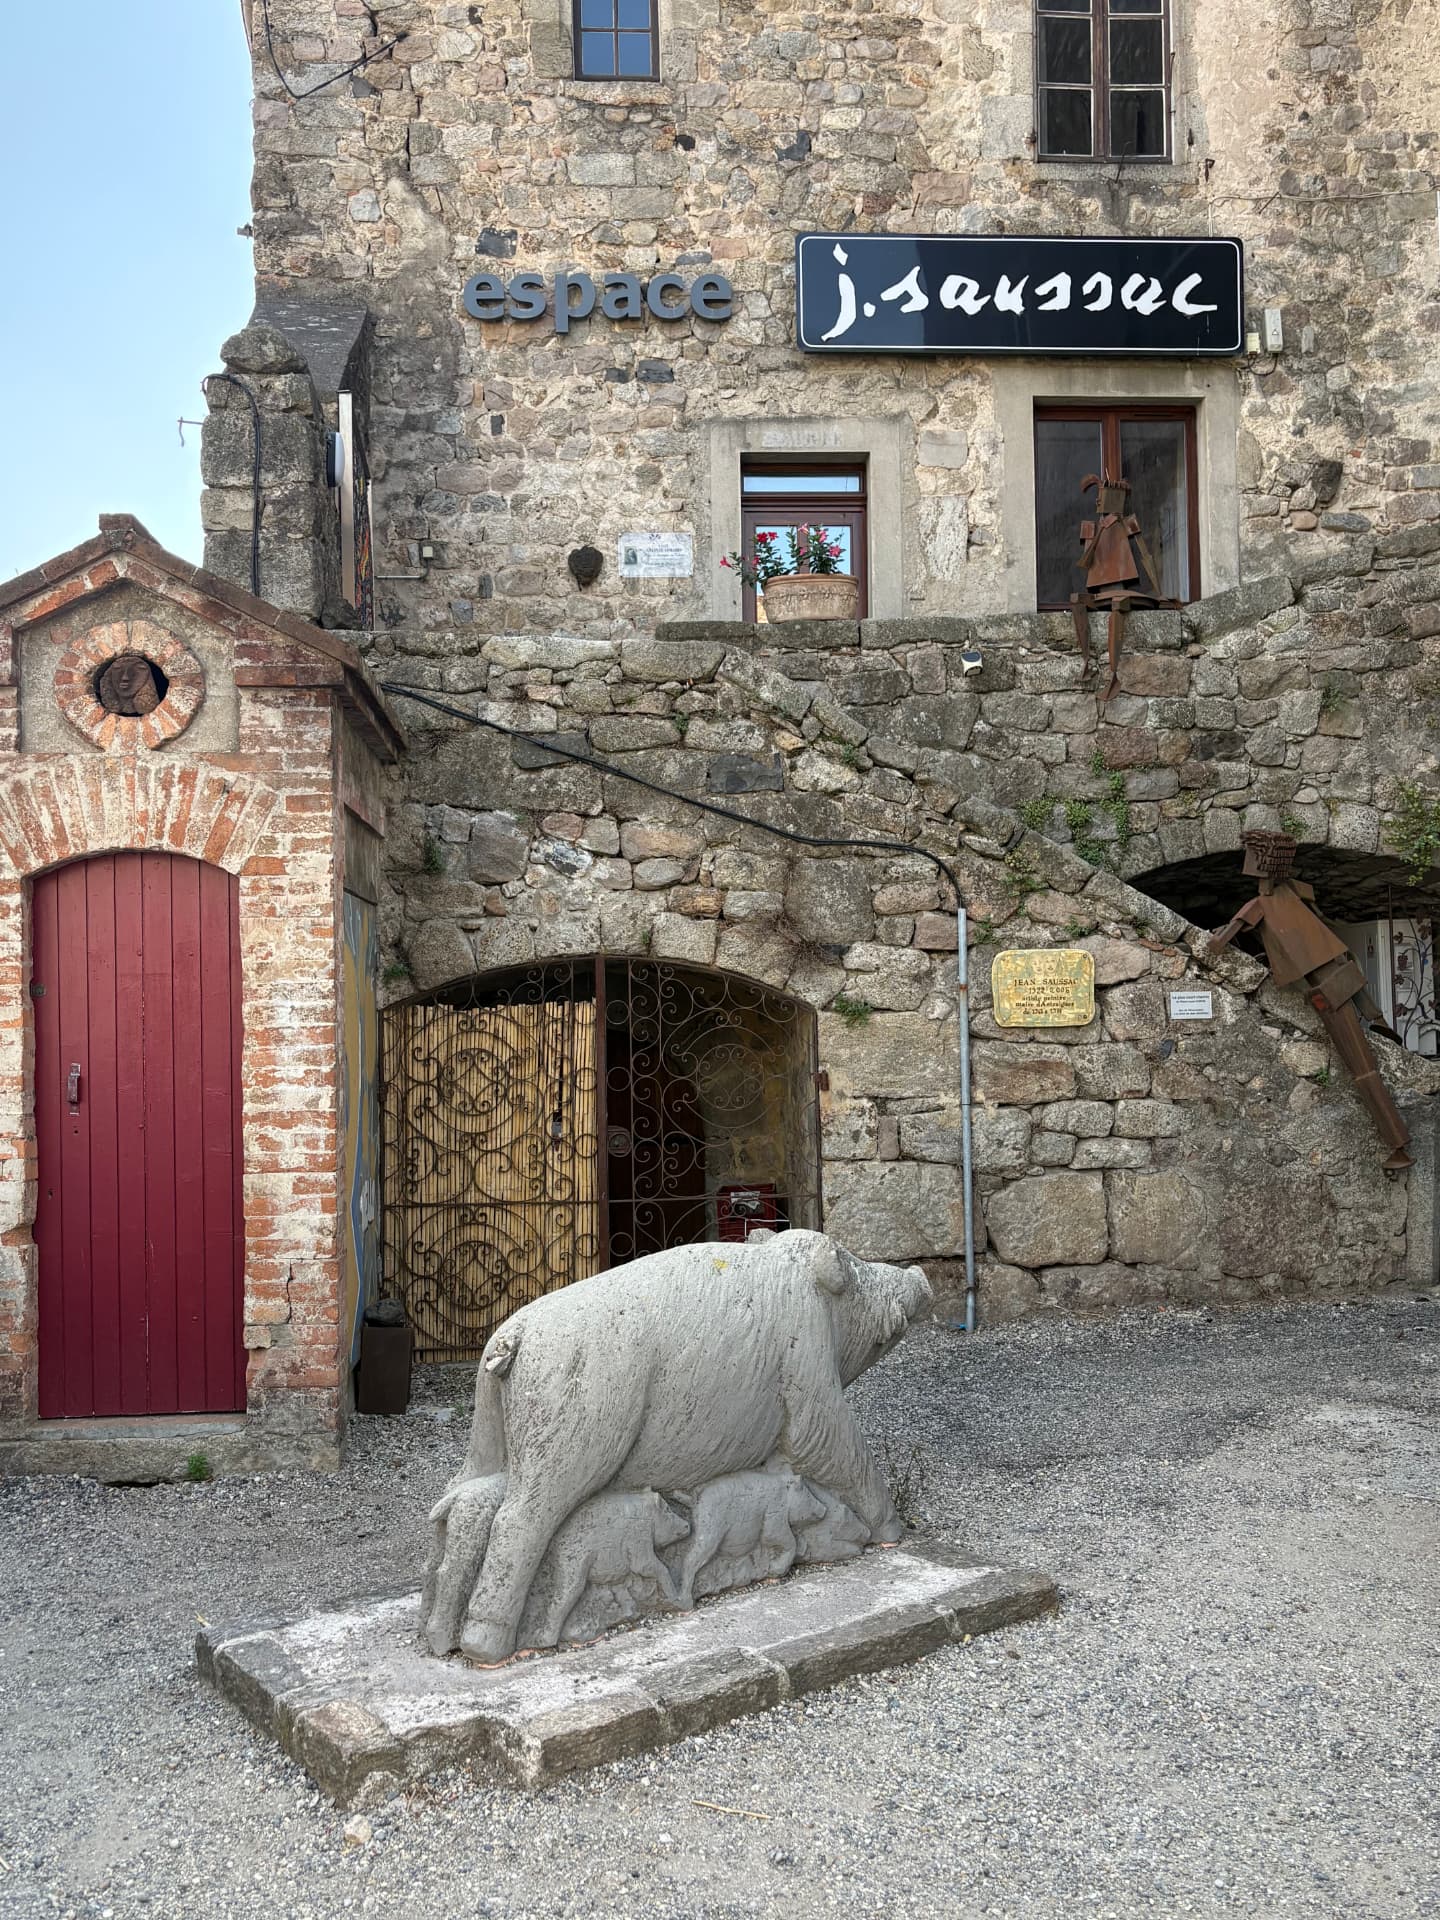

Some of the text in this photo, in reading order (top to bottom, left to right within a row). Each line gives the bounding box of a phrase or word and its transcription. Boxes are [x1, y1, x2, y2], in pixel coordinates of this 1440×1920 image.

[463, 272, 733, 334] espace
[1014, 978, 1079, 987] JEAN SAUSSAC
